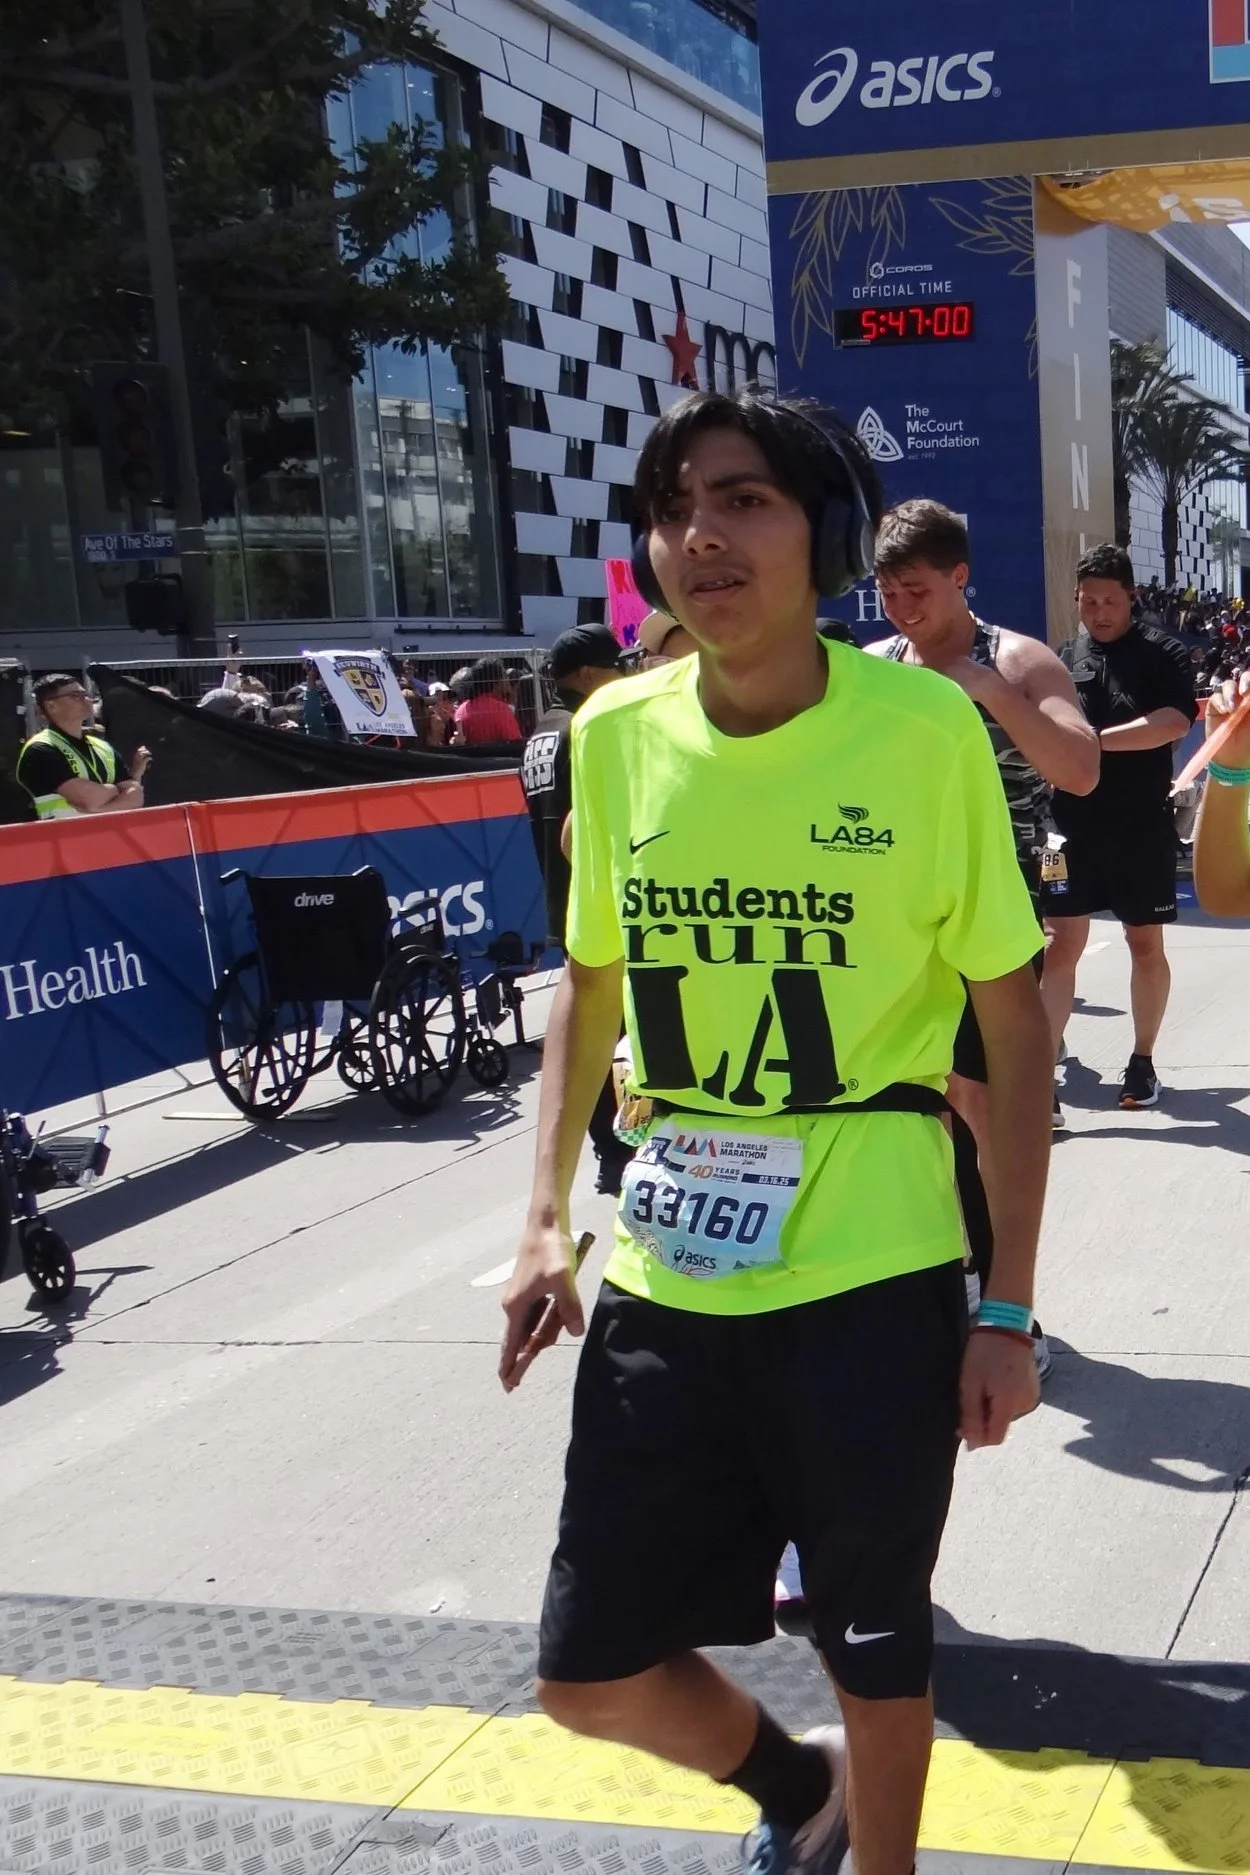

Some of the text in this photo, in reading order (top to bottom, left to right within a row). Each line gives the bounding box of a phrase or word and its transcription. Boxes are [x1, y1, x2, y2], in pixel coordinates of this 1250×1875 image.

[860, 50, 995, 109] asics
[885, 263, 933, 274] COROS
[852, 280, 953, 299] OFFICIAL TIME
[904, 404, 930, 418] The
[906, 419, 964, 434] McCourt
[906, 434, 980, 450] Foundation
[105, 536, 118, 550] Of
[120, 535, 141, 549] The
[143, 534, 173, 548] Stars
[810, 823, 896, 848] LA84
[821, 844, 886, 855] FOUNDATION
[294, 892, 335, 908] drive
[622, 876, 855, 925] Students
[622, 923, 858, 968] run
[1, 940, 148, 1020] Health
[627, 964, 847, 1107] LA
[720, 1148, 767, 1160] MARATHON
[721, 1141, 768, 1152] LOS ANGELES
[688, 1164, 741, 1179] 40 YEARS
[632, 1179, 769, 1245] 33160
[685, 1251, 717, 1271] asics
